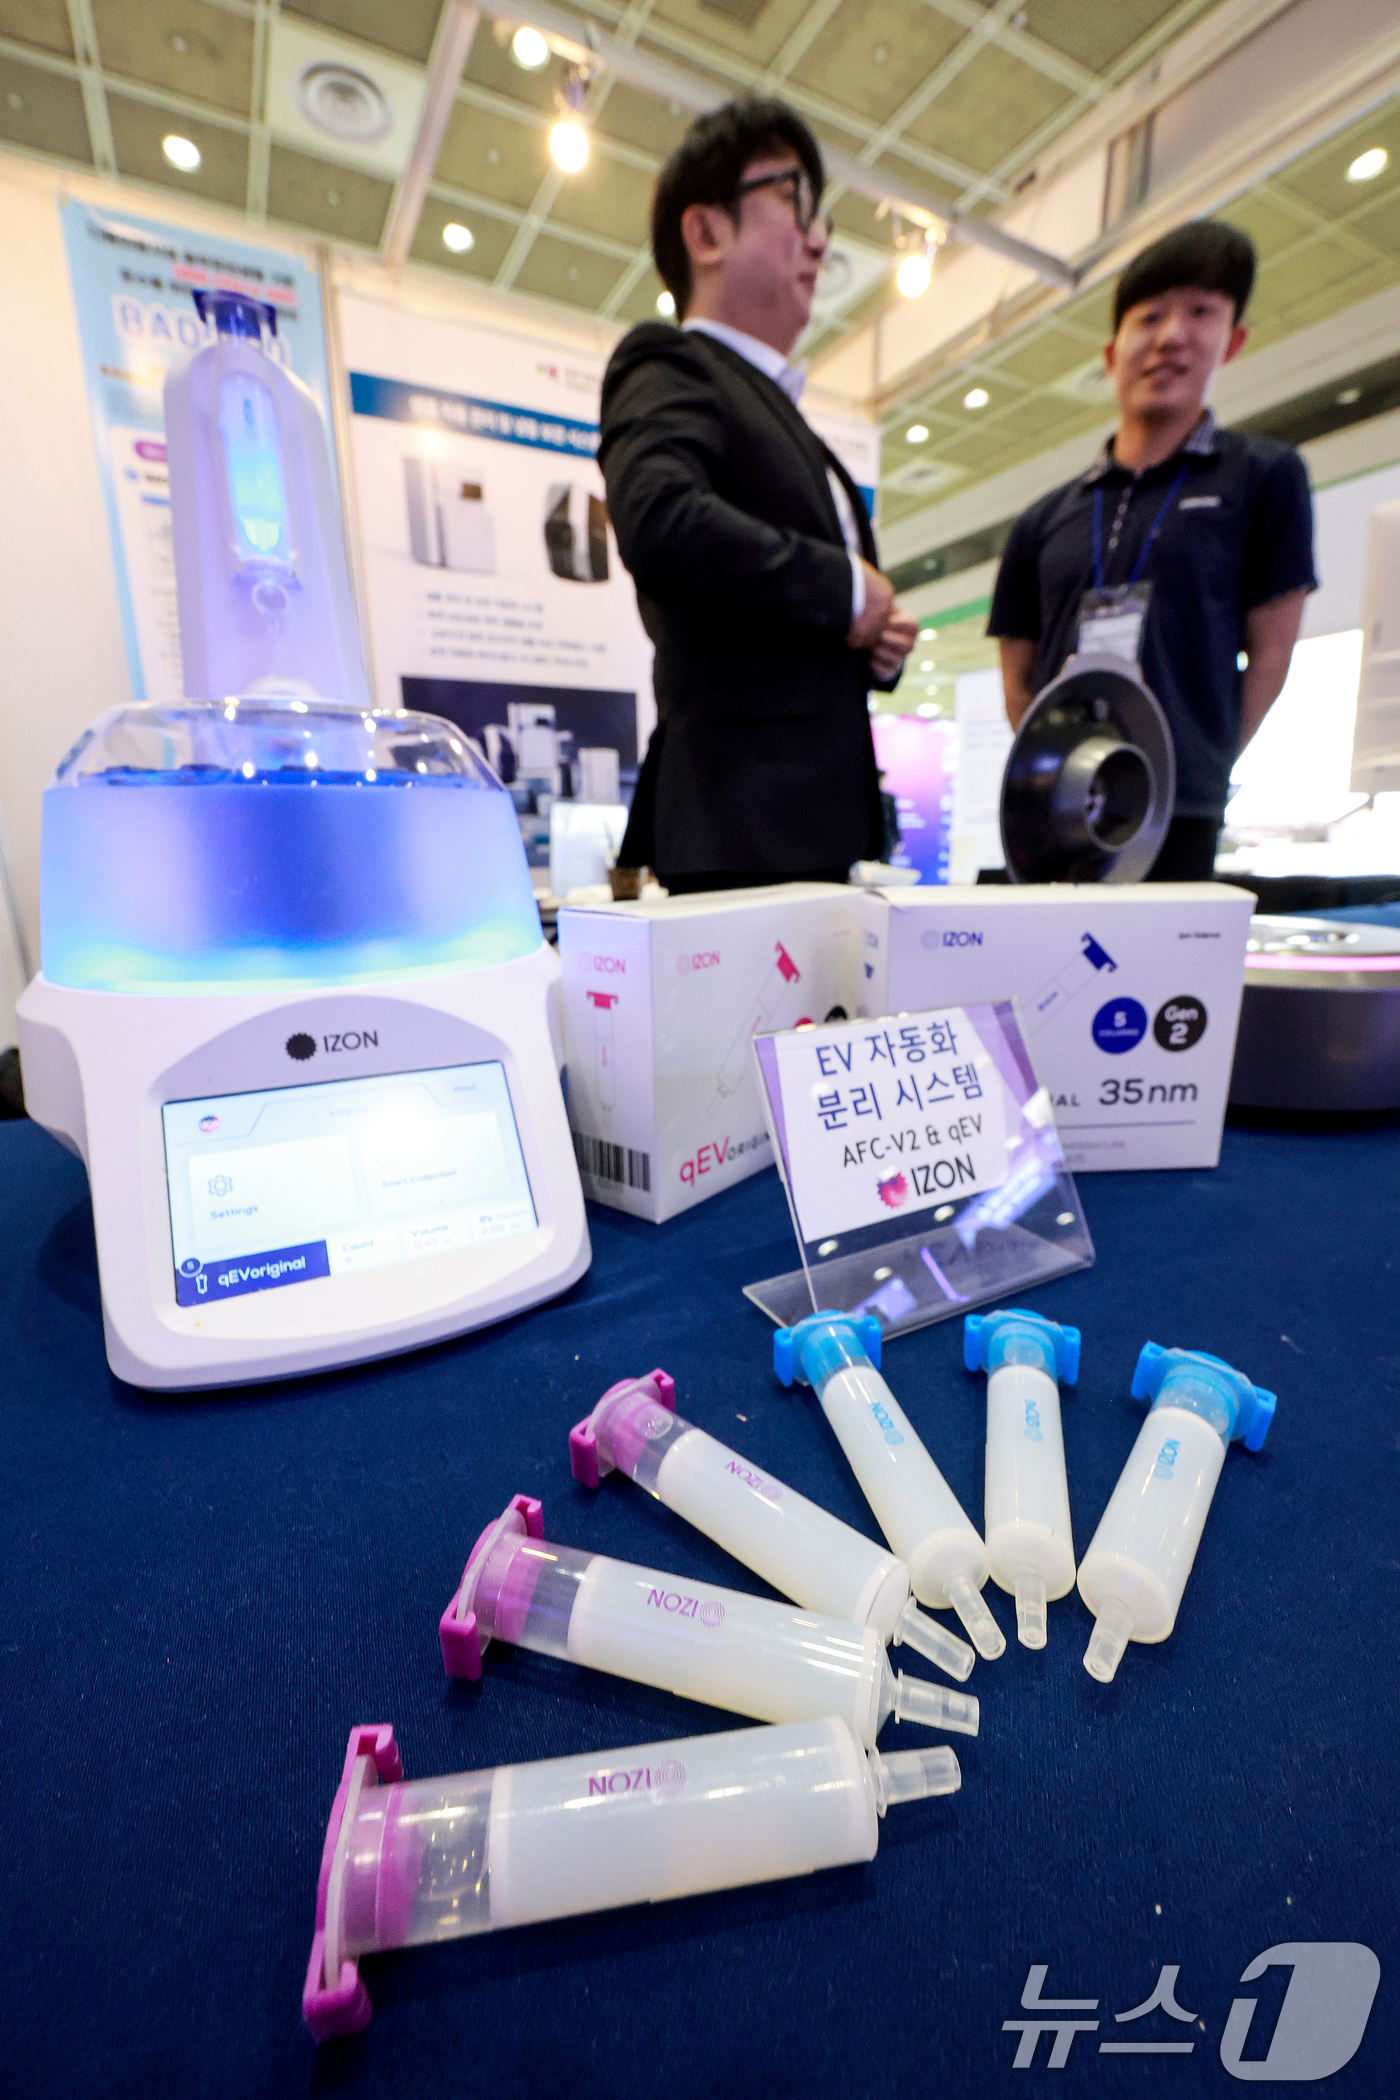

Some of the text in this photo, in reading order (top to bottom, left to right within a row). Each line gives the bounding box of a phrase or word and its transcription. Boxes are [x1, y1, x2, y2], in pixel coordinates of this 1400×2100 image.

[944, 931, 983, 947] IZON
[594, 956, 626, 973] IZON
[692, 951, 720, 969] IZON
[1164, 1005, 1199, 1021] Gen
[323, 1030, 378, 1053] IZON
[1169, 1023, 1188, 1044] 2
[815, 1020, 957, 1076] EV 자동화
[817, 1063, 983, 1130] 분리 시스템
[1100, 1078, 1198, 1105] 35nm
[843, 1114, 983, 1167] AFC-V2 & qEV
[381, 1169, 457, 1189] Start Collection
[911, 1154, 976, 1195] IZON
[210, 1205, 259, 1219] Settings
[411, 1224, 449, 1238] Volume
[342, 1239, 374, 1252] Count
[217, 1255, 306, 1288] qEVoriginal
[725, 1460, 764, 1489] IZON
[647, 1588, 699, 1619] IZON
[588, 1767, 651, 1796] IZON
